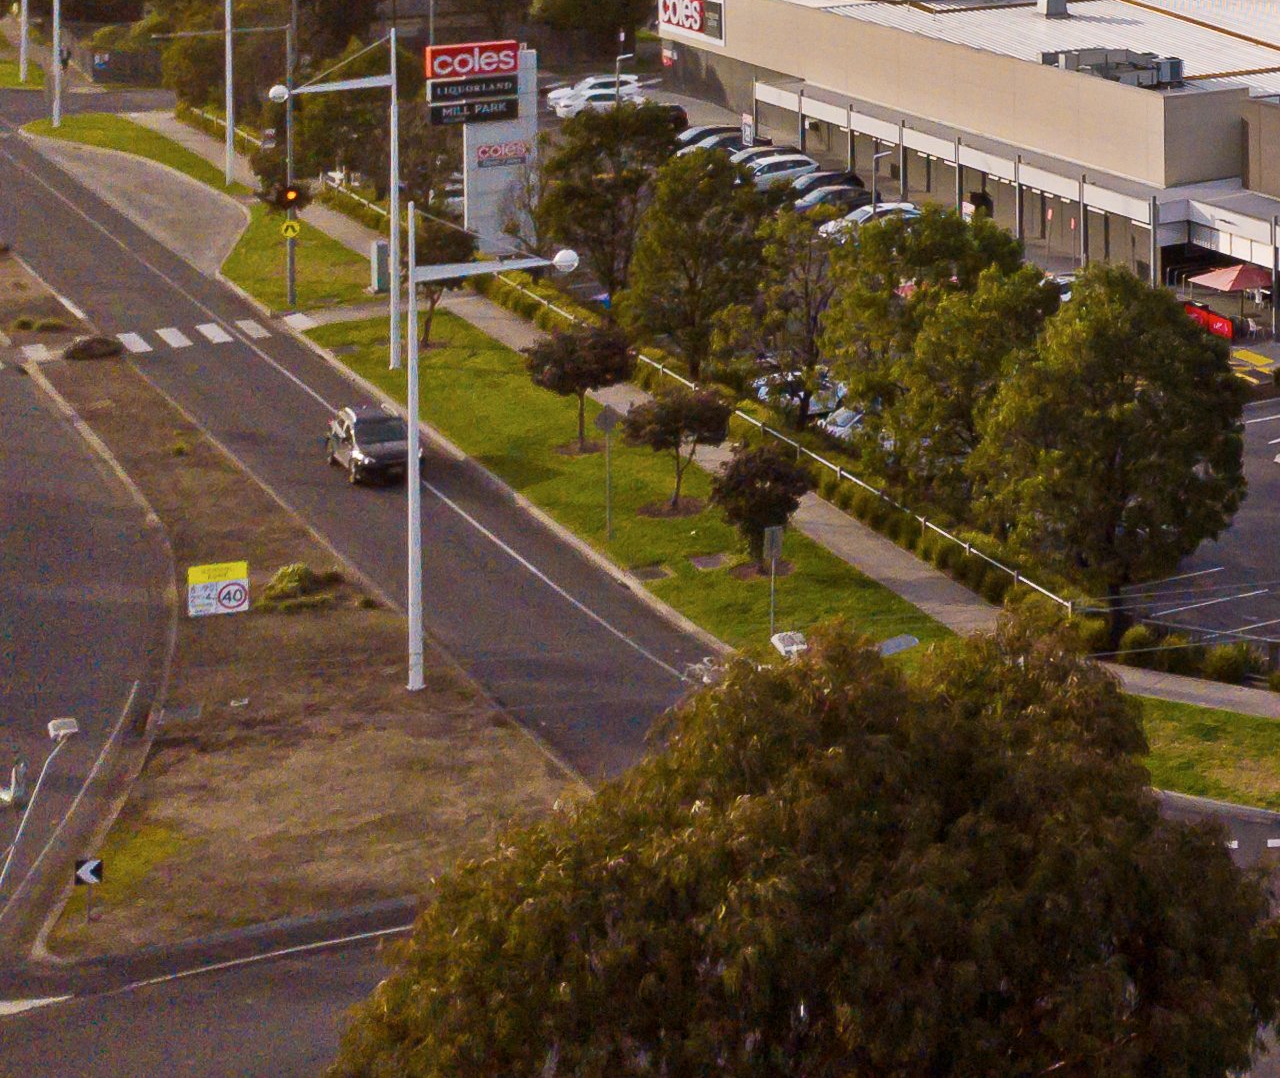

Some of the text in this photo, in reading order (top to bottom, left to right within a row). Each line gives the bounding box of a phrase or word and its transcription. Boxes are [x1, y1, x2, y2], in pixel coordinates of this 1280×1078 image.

[434, 48, 515, 74] coles
[437, 82, 512, 95] LIQUORLAND
[442, 103, 507, 116] MILL PARK
[478, 143, 525, 159] coles
[222, 588, 243, 604] 40
